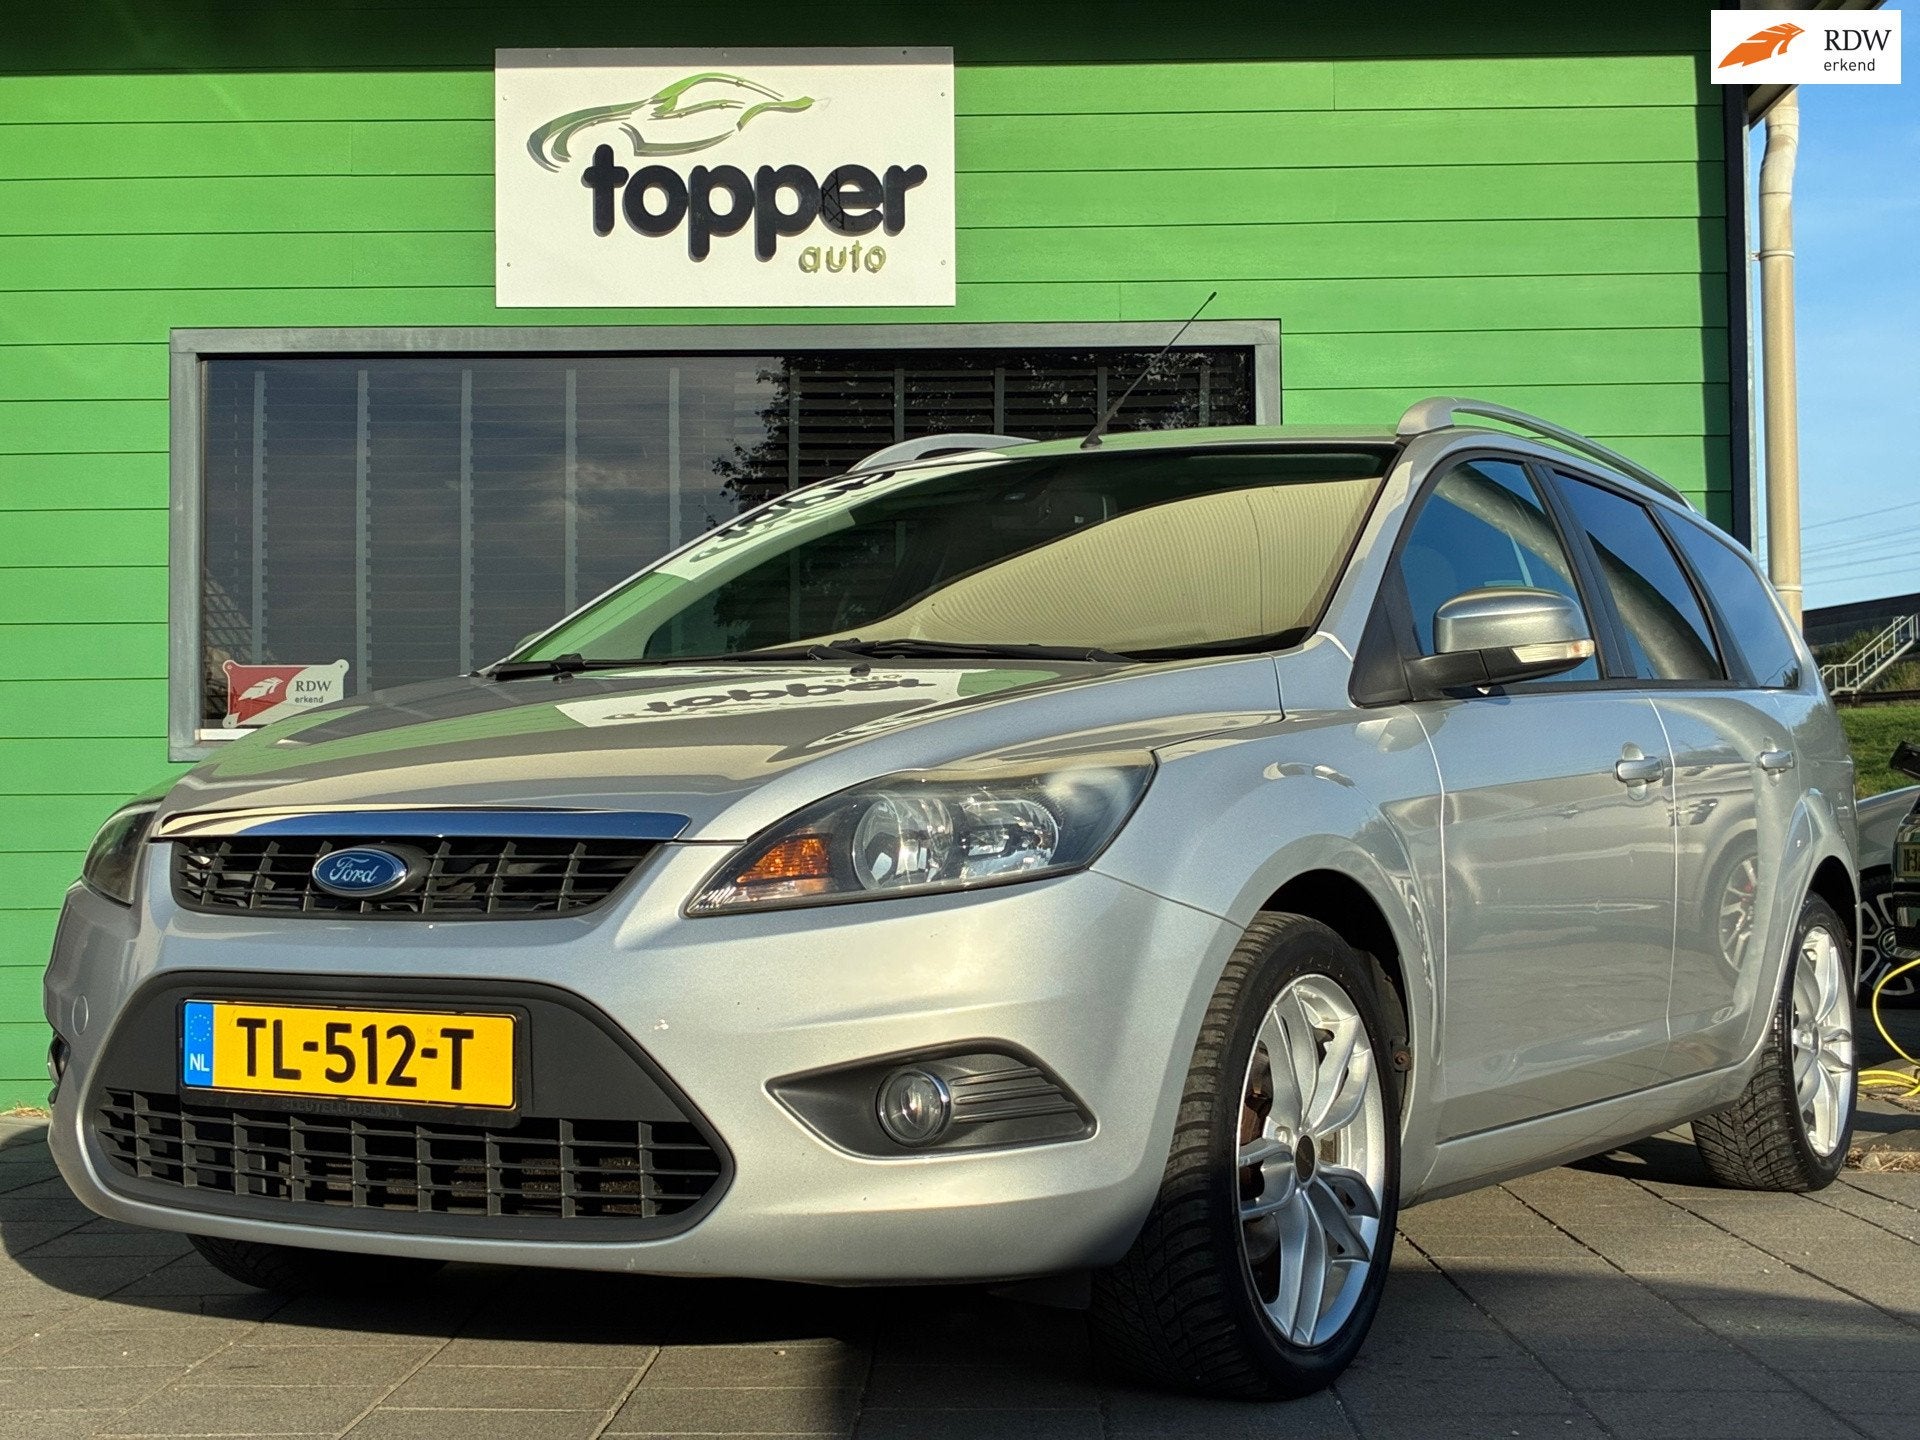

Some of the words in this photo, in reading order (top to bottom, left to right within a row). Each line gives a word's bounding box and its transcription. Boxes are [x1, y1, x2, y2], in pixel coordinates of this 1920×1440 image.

[581, 143, 928, 263] topper
[799, 240, 887, 273] auto
[295, 680, 332, 692] RDW
[295, 695, 324, 704] erkend
[329, 856, 381, 883] Ford
[189, 1053, 210, 1072] NL
[236, 1017, 475, 1091] TL-512-T
